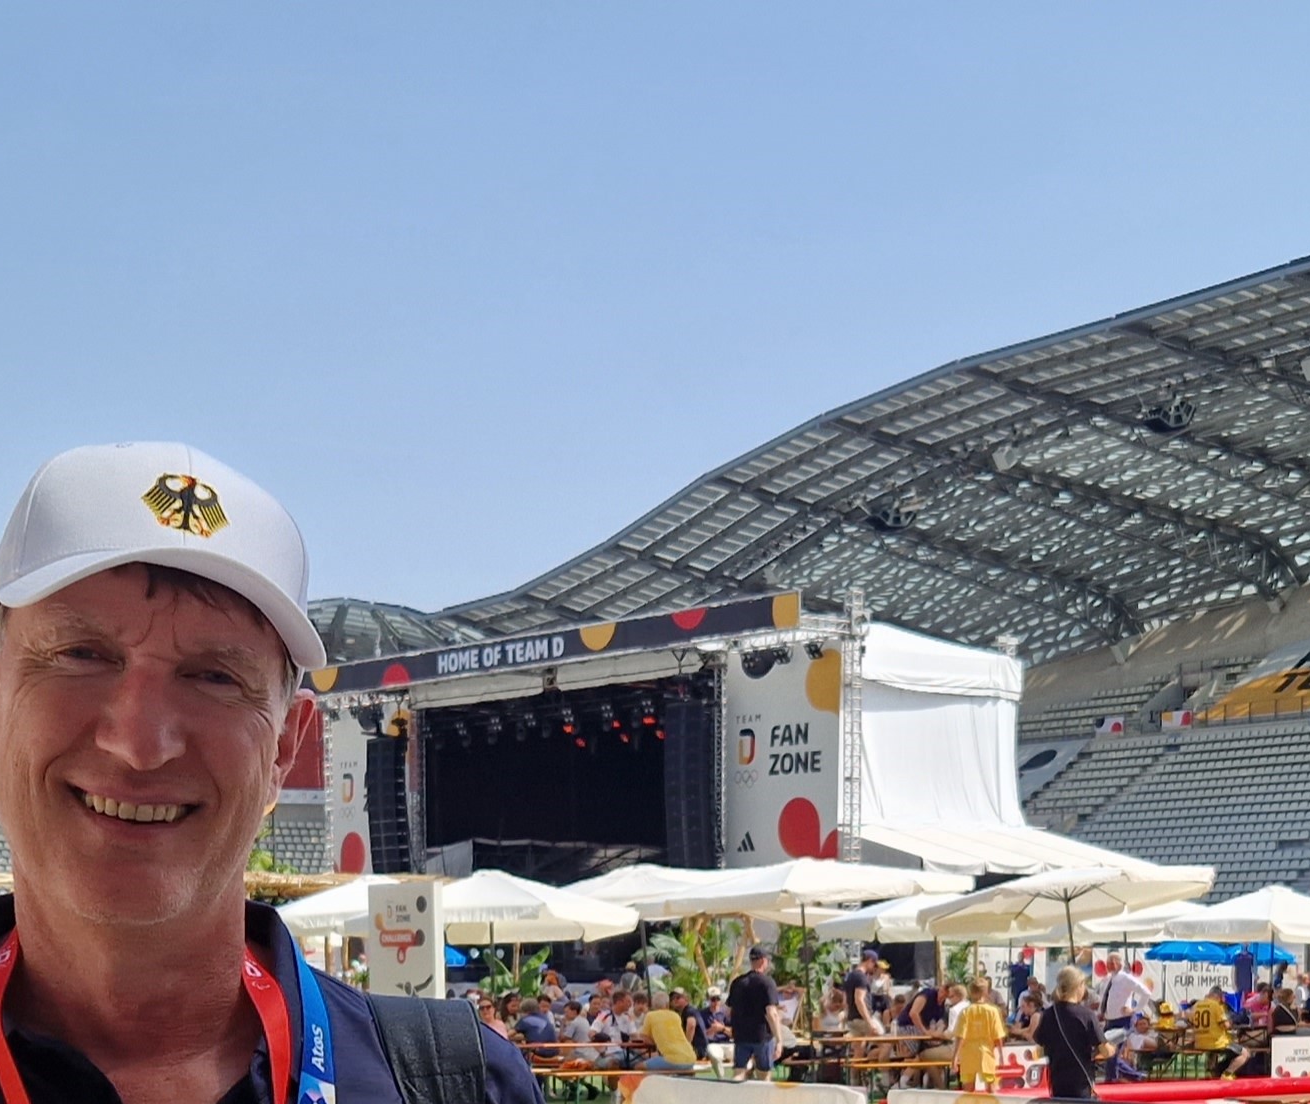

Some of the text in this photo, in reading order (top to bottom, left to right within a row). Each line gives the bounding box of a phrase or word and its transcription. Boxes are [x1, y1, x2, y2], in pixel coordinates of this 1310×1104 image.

[437, 636, 565, 675] HOME OF TEAM D
[736, 714, 762, 725] TEAM
[770, 722, 810, 748] FAN
[768, 750, 822, 776] ZONE
[1174, 972, 1195, 987] FÜR
[311, 1023, 326, 1073] Atos
